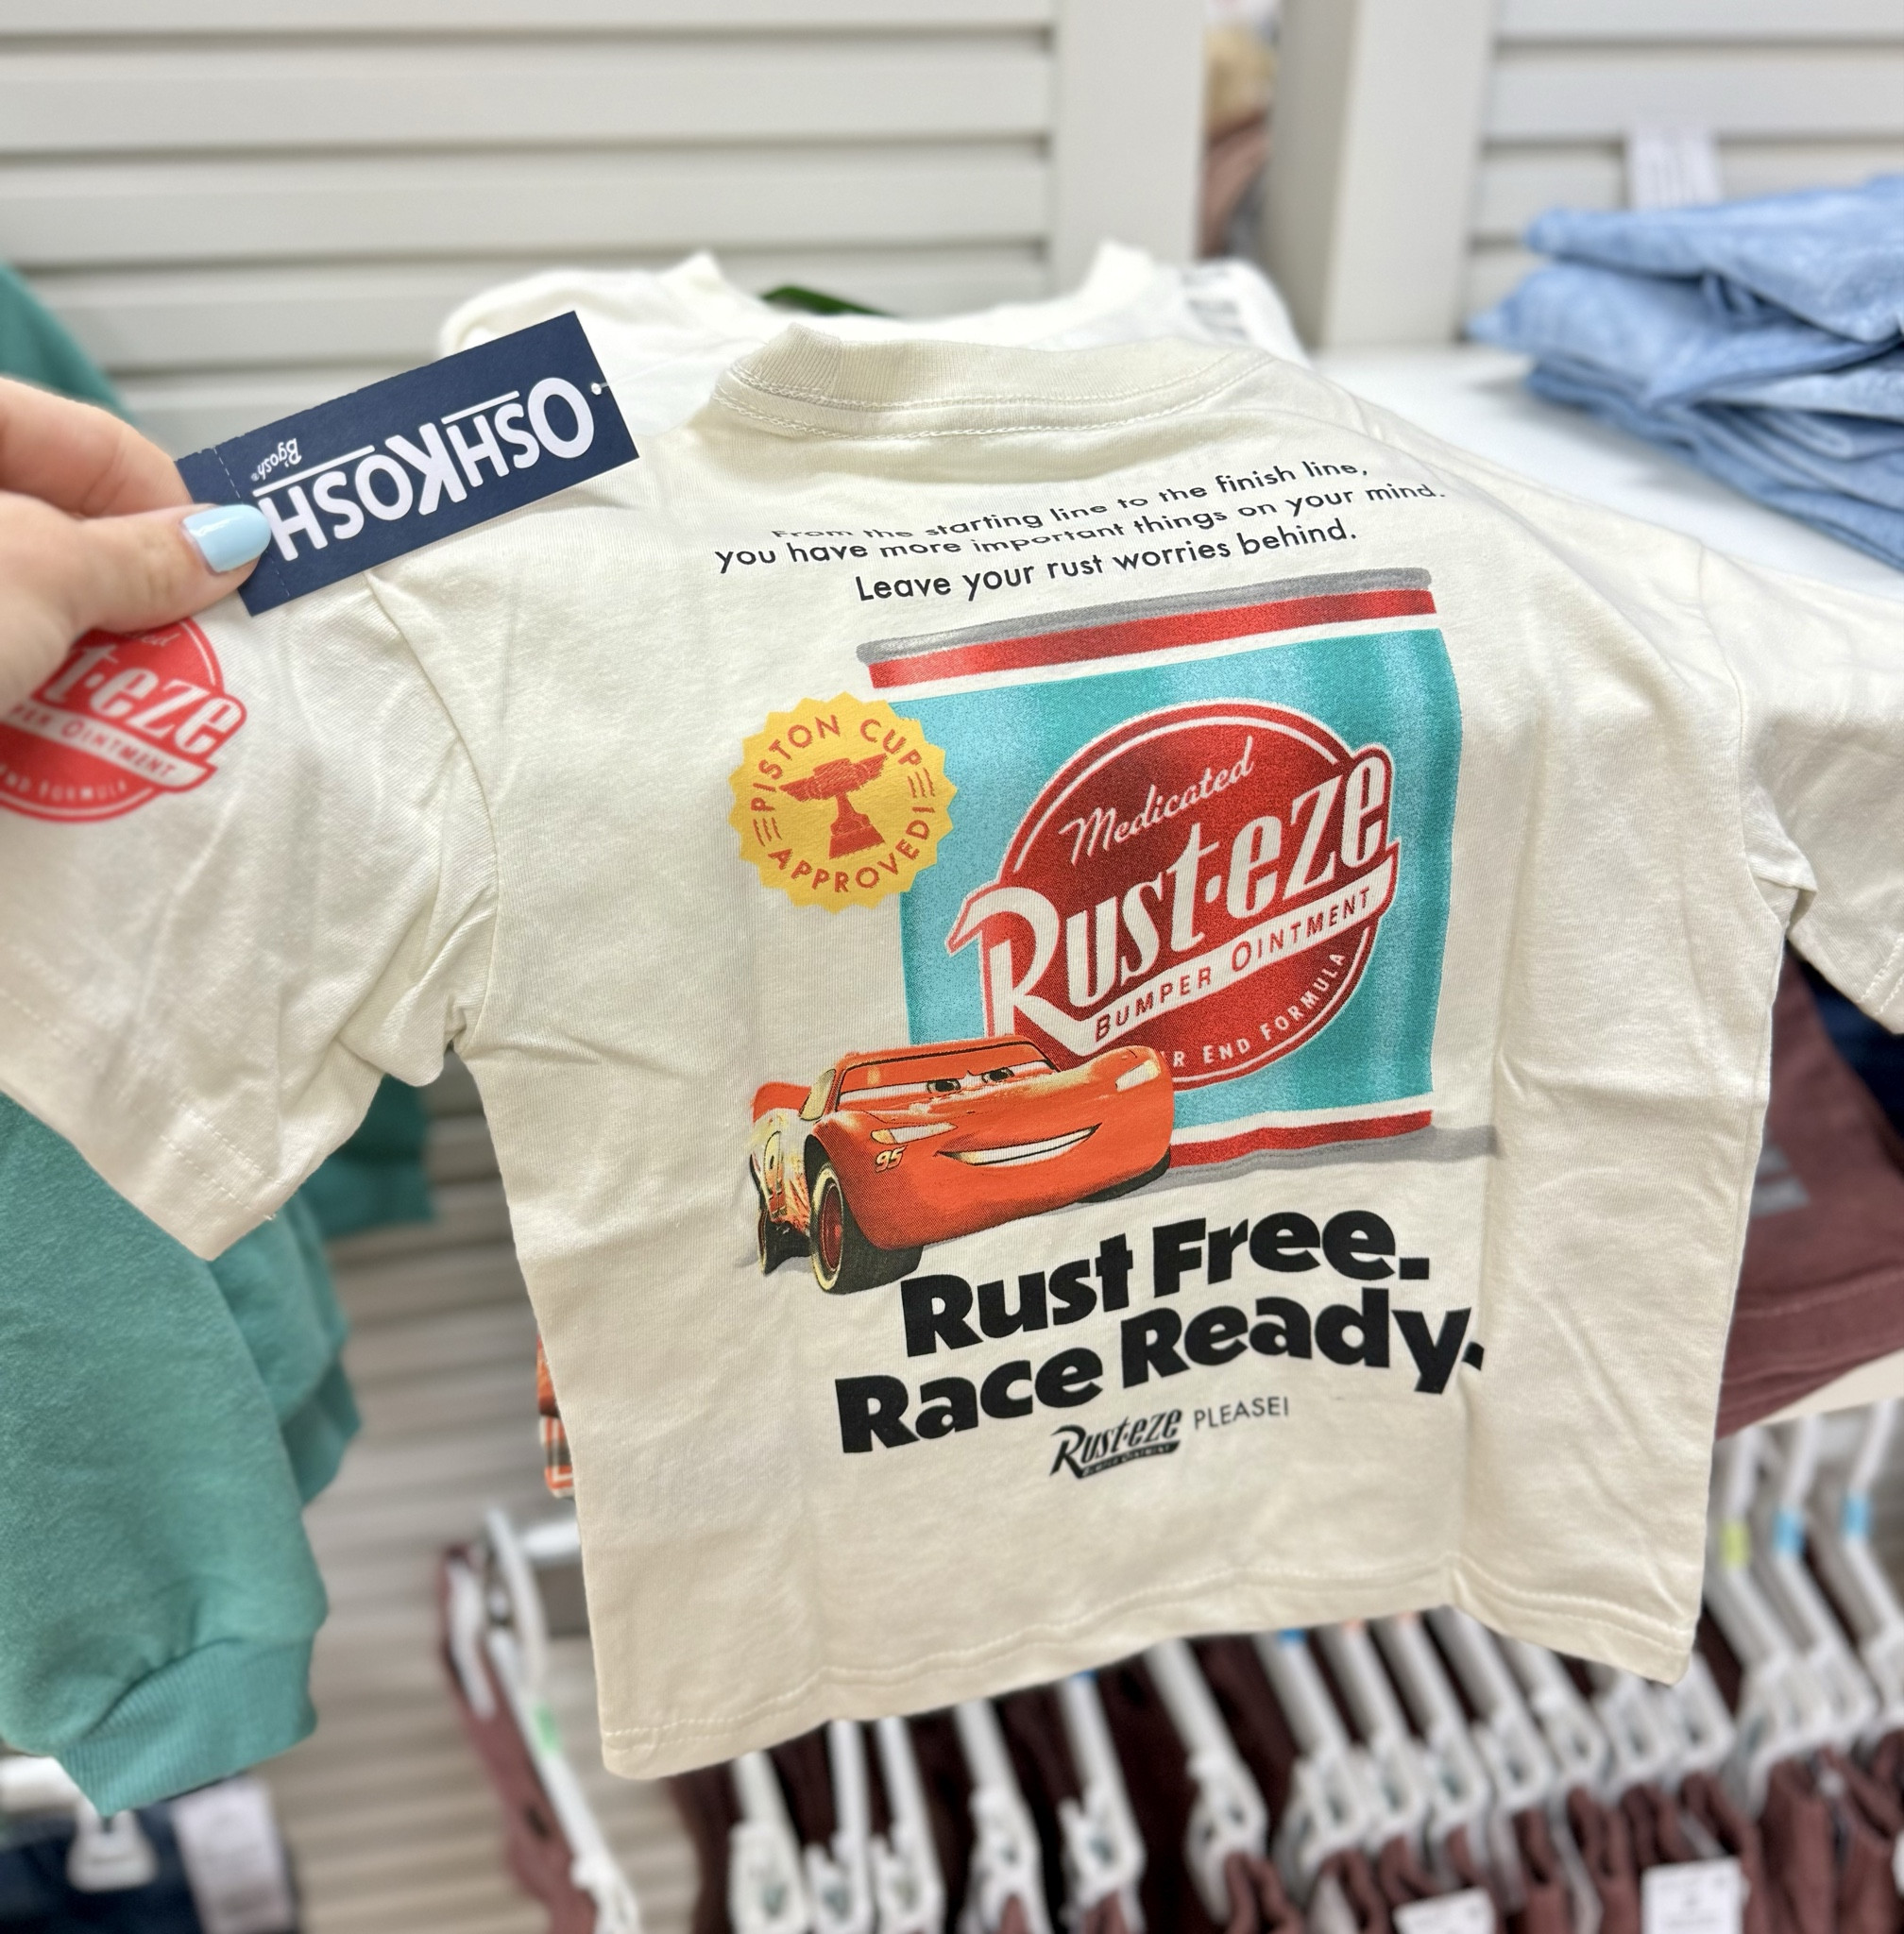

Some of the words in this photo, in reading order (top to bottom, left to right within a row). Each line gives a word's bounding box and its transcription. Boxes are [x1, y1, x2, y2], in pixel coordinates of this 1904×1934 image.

[714, 550, 776, 575] you
[785, 541, 869, 563] have
[878, 541, 962, 558] more
[971, 518, 1125, 553] important
[1132, 511, 1229, 534] things
[1236, 503, 1278, 517] on
[1283, 489, 1354, 518] your
[1364, 483, 1447, 501] mind.
[770, 529, 854, 539] From
[862, 529, 914, 539] the
[925, 514, 1044, 537] starting
[1048, 505, 1109, 523] line
[1116, 498, 1148, 509] to
[1158, 485, 1208, 503] the
[1215, 465, 1297, 494] finish
[1300, 460, 1368, 478] line,
[855, 575, 952, 602] Leave
[961, 565, 1035, 602] your
[1046, 553, 1104, 580] rust
[1111, 539, 1232, 571] worries
[1235, 517, 1358, 556] behind.
[750, 714, 842, 813] PISTON
[858, 719, 923, 767] CUP
[1058, 735, 1254, 867] Medicated
[1095, 965, 1213, 1042] BUMPER
[1231, 885, 1371, 972] OINTMENT
[1201, 1039, 1251, 1064] END
[1259, 953, 1346, 1042] FORMULA
[875, 1145, 909, 1174] 95
[900, 1232, 1133, 1358] Rust
[1152, 1209, 1431, 1298] Free.
[834, 1347, 1104, 1454] Race
[1120, 1286, 1485, 1395] Ready.
